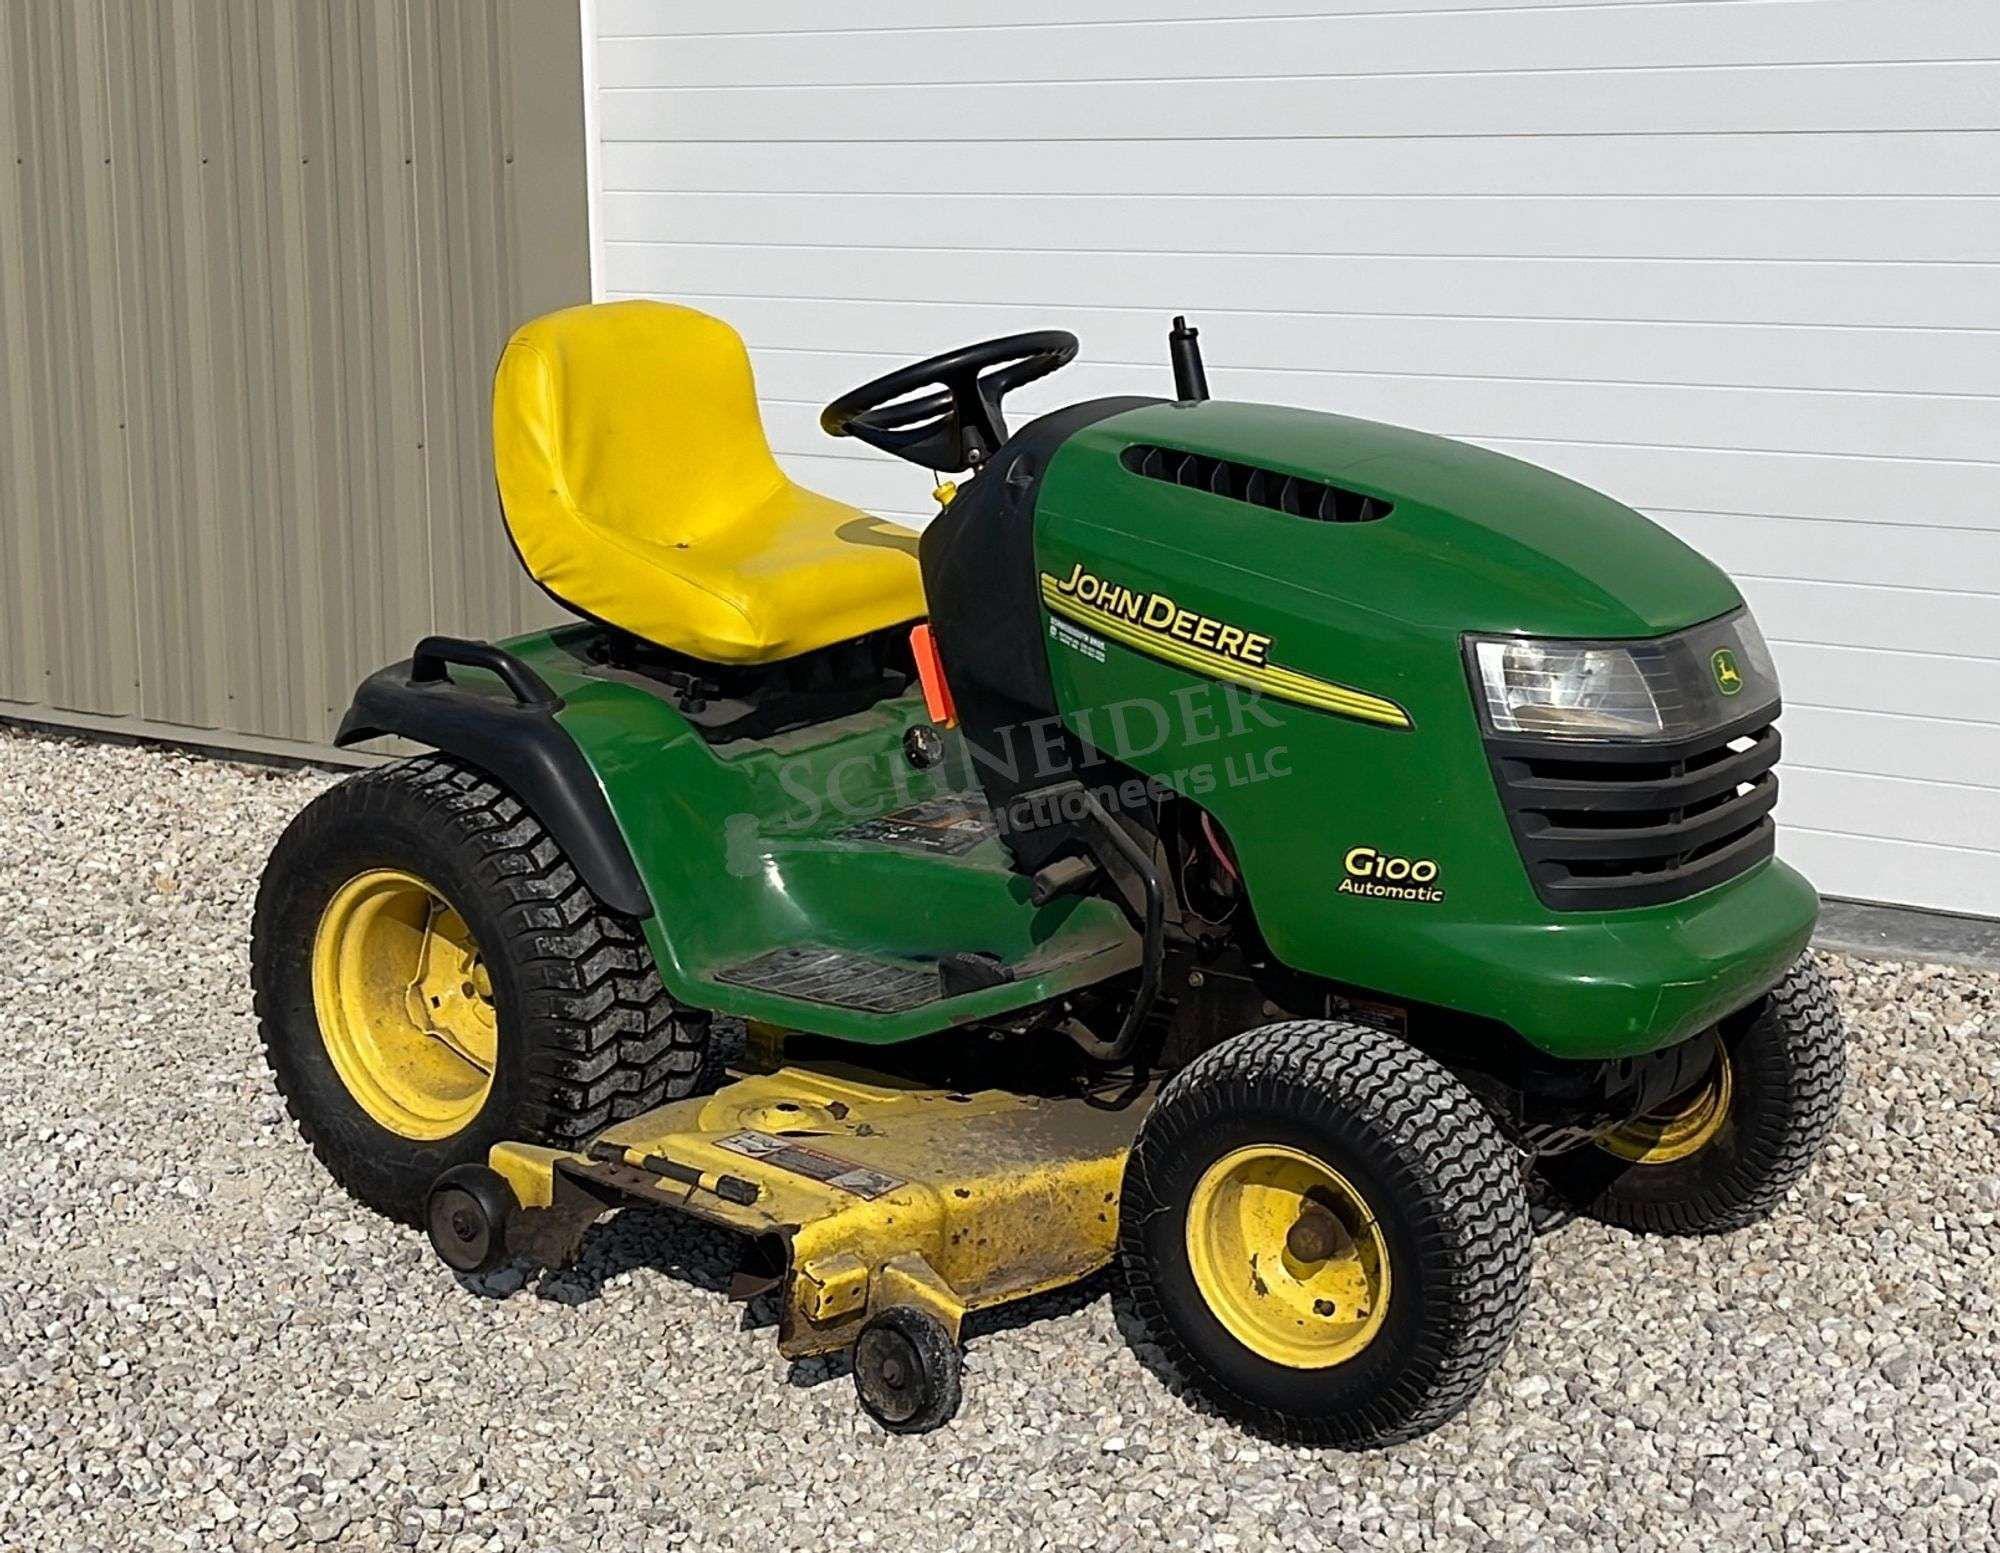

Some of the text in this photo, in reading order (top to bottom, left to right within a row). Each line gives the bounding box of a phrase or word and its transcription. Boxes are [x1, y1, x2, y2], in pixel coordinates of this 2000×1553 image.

[1058, 563, 1143, 620] JOHN
[1142, 594, 1271, 664] DEERE
[1345, 847, 1437, 882] G100
[1338, 878, 1443, 902] Automatic
